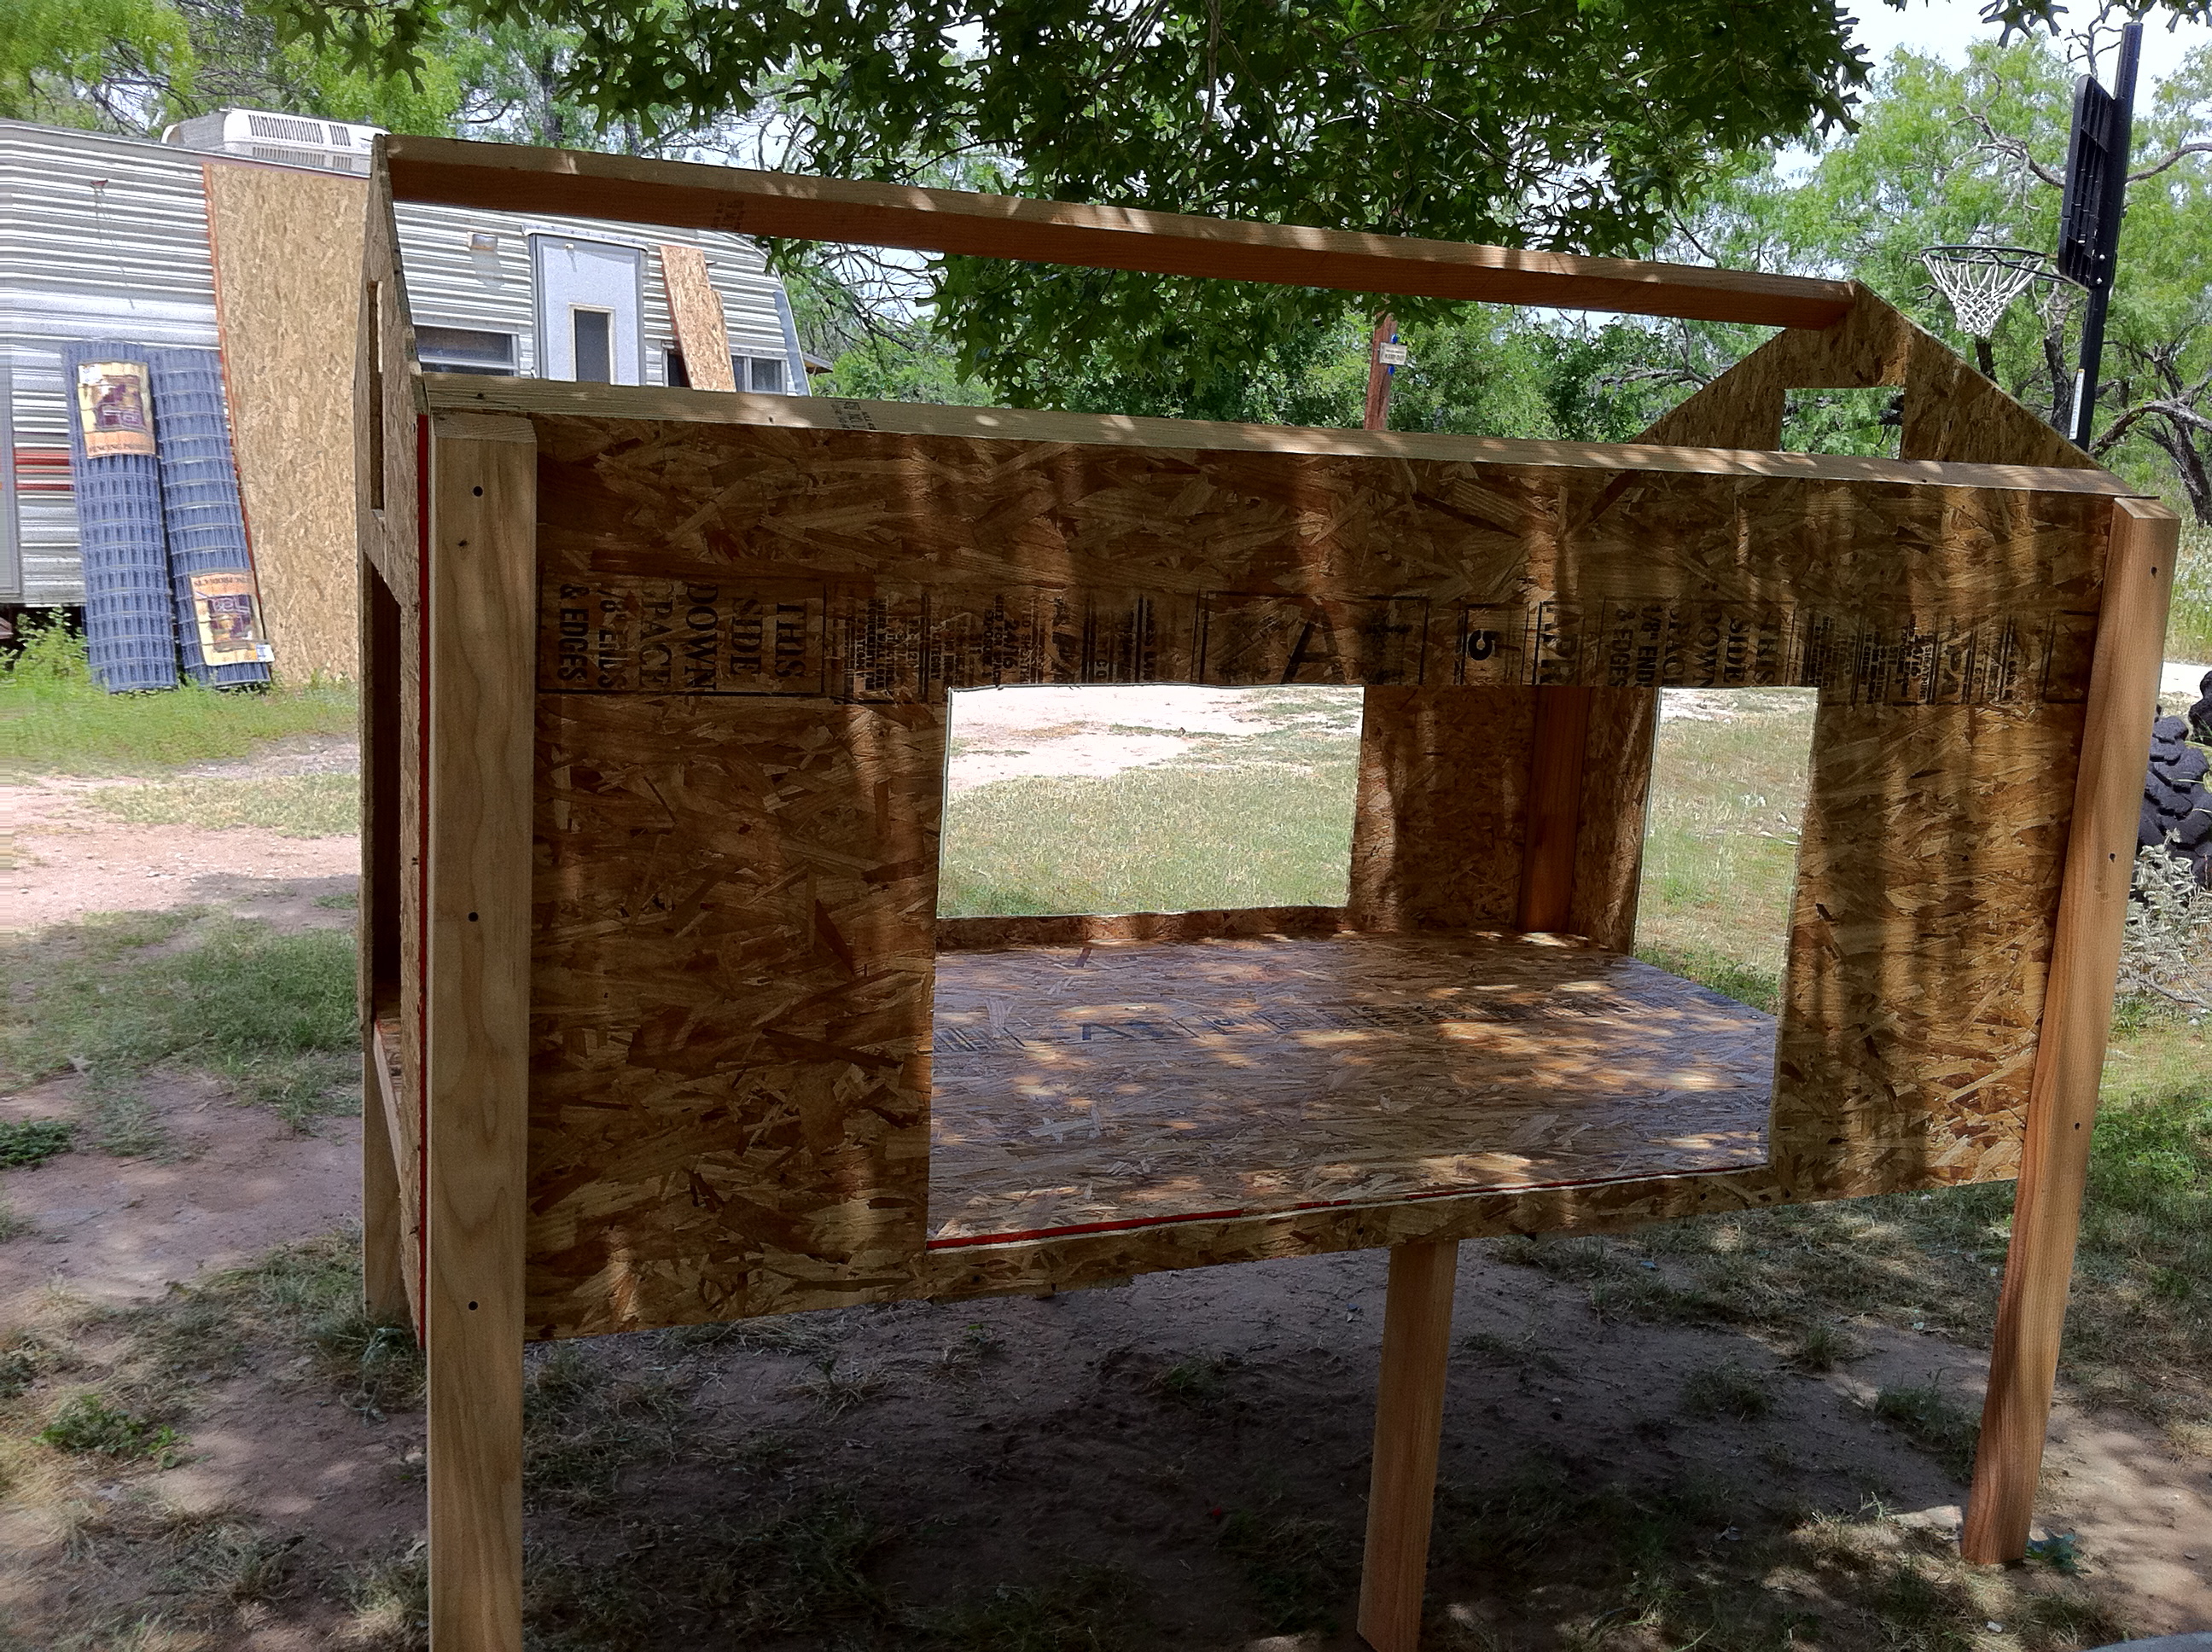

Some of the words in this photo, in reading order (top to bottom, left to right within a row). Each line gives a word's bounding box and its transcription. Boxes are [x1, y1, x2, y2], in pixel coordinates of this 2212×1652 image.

[560, 584, 590, 599] &
[1615, 609, 1635, 621] &
[557, 608, 589, 680] EDGES
[684, 584, 719, 689] DOWN
[731, 597, 763, 675] SIDE
[775, 602, 806, 678] THIS
[931, 633, 941, 680] CATEGORY
[1003, 620, 1020, 669] 24/16
[1468, 630, 1504, 661] 5
[1608, 629, 1633, 687] EDGES
[1723, 618, 1749, 683] SIDE
[1754, 618, 1780, 684] THIS
